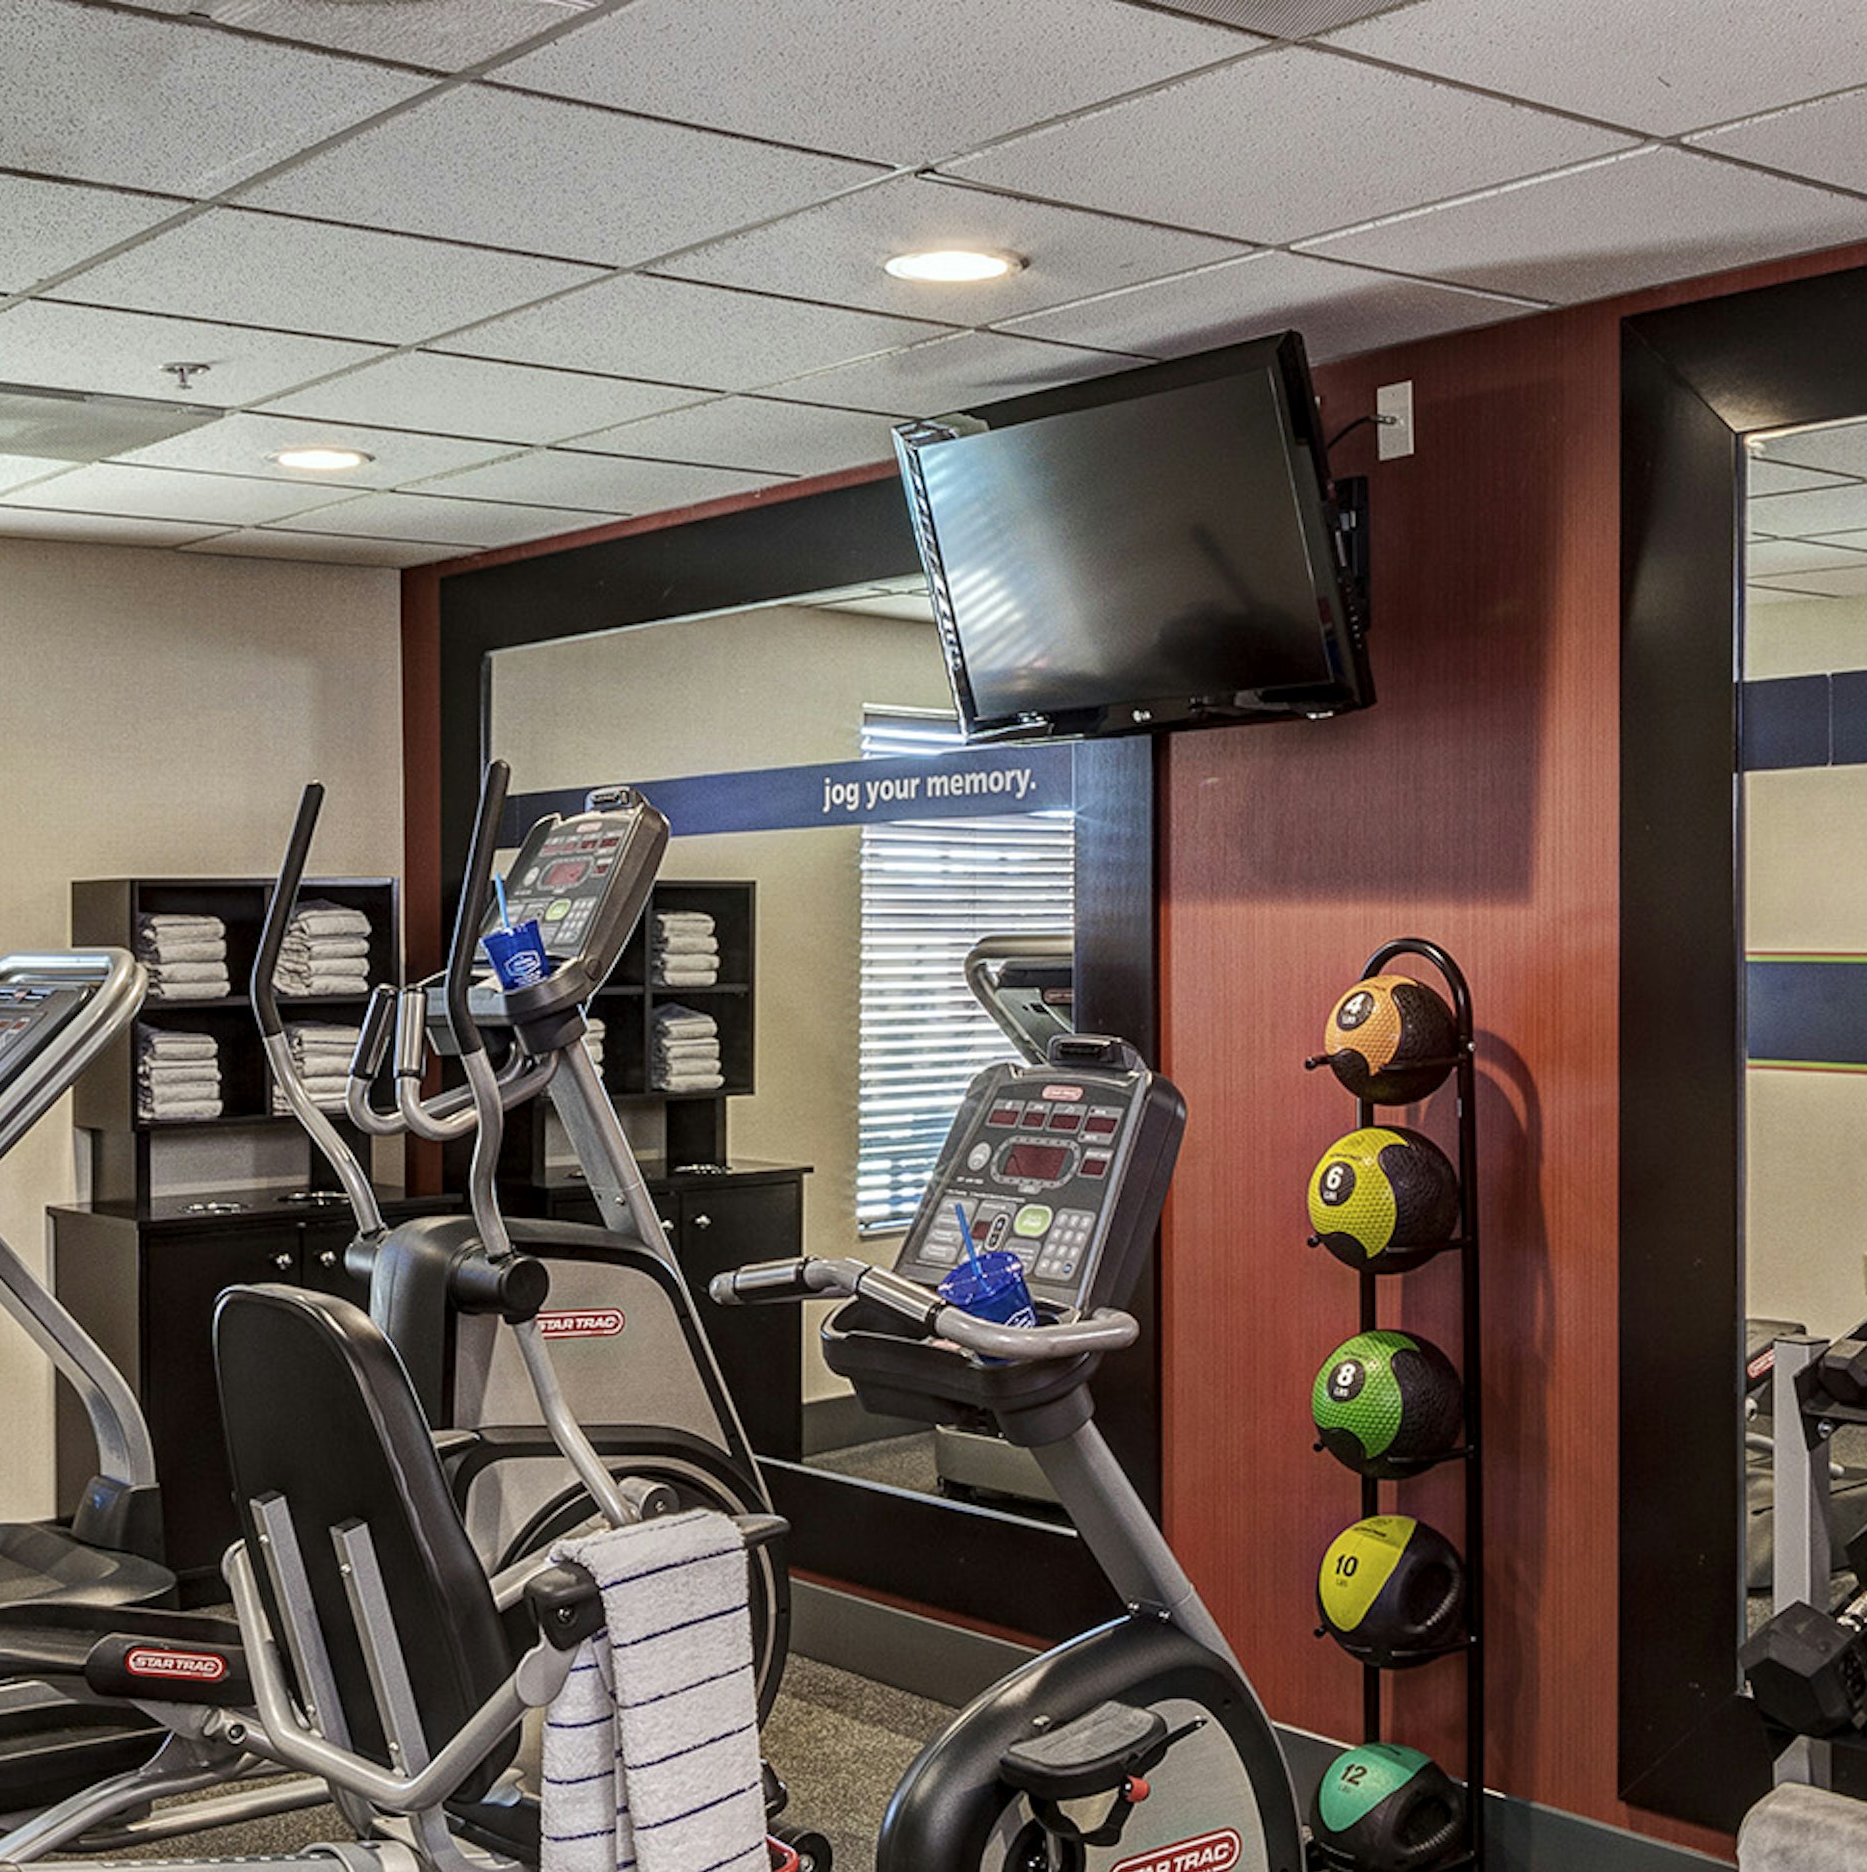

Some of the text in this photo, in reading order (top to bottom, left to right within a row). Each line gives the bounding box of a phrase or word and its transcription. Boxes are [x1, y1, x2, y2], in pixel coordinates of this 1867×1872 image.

[823, 768, 1037, 812] jog your memory.
[1344, 992, 1366, 1014] 4
[1326, 1165, 1344, 1190] 6
[575, 1316, 616, 1329] TRAC
[1337, 1363, 1357, 1387] 8
[1336, 1554, 1359, 1577] 10
[134, 1656, 217, 1673] STAR TRAC
[1341, 1763, 1367, 1786] 12
[1173, 1842, 1231, 1872] TRAC
